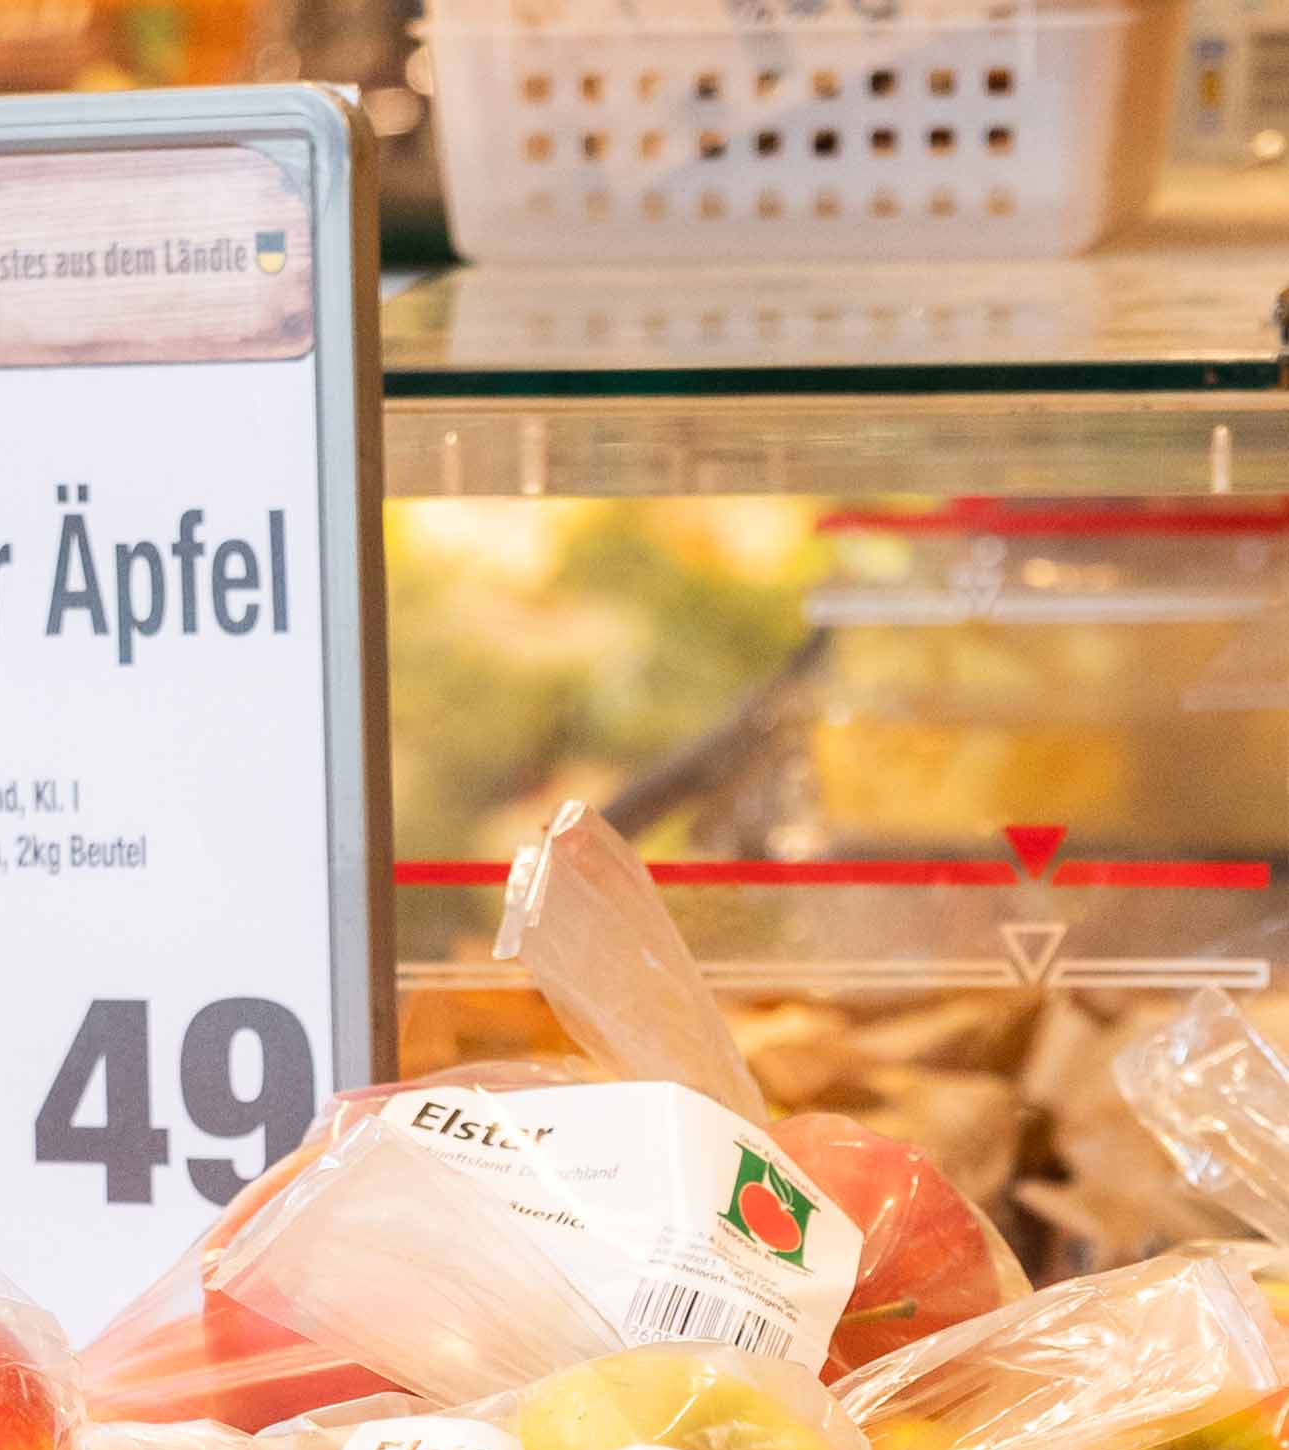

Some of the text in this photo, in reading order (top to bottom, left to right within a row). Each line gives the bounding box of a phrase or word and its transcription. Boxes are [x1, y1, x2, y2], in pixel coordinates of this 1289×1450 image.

[53, 252, 97, 278] aus
[104, 241, 157, 277] dem
[164, 238, 249, 274] Ländle
[45, 484, 291, 666] Äpfel
[33, 780, 64, 812] Kl.
[17, 833, 61, 873] 2kg
[69, 833, 148, 867] Beutel
[32, 997, 317, 1207] 49
